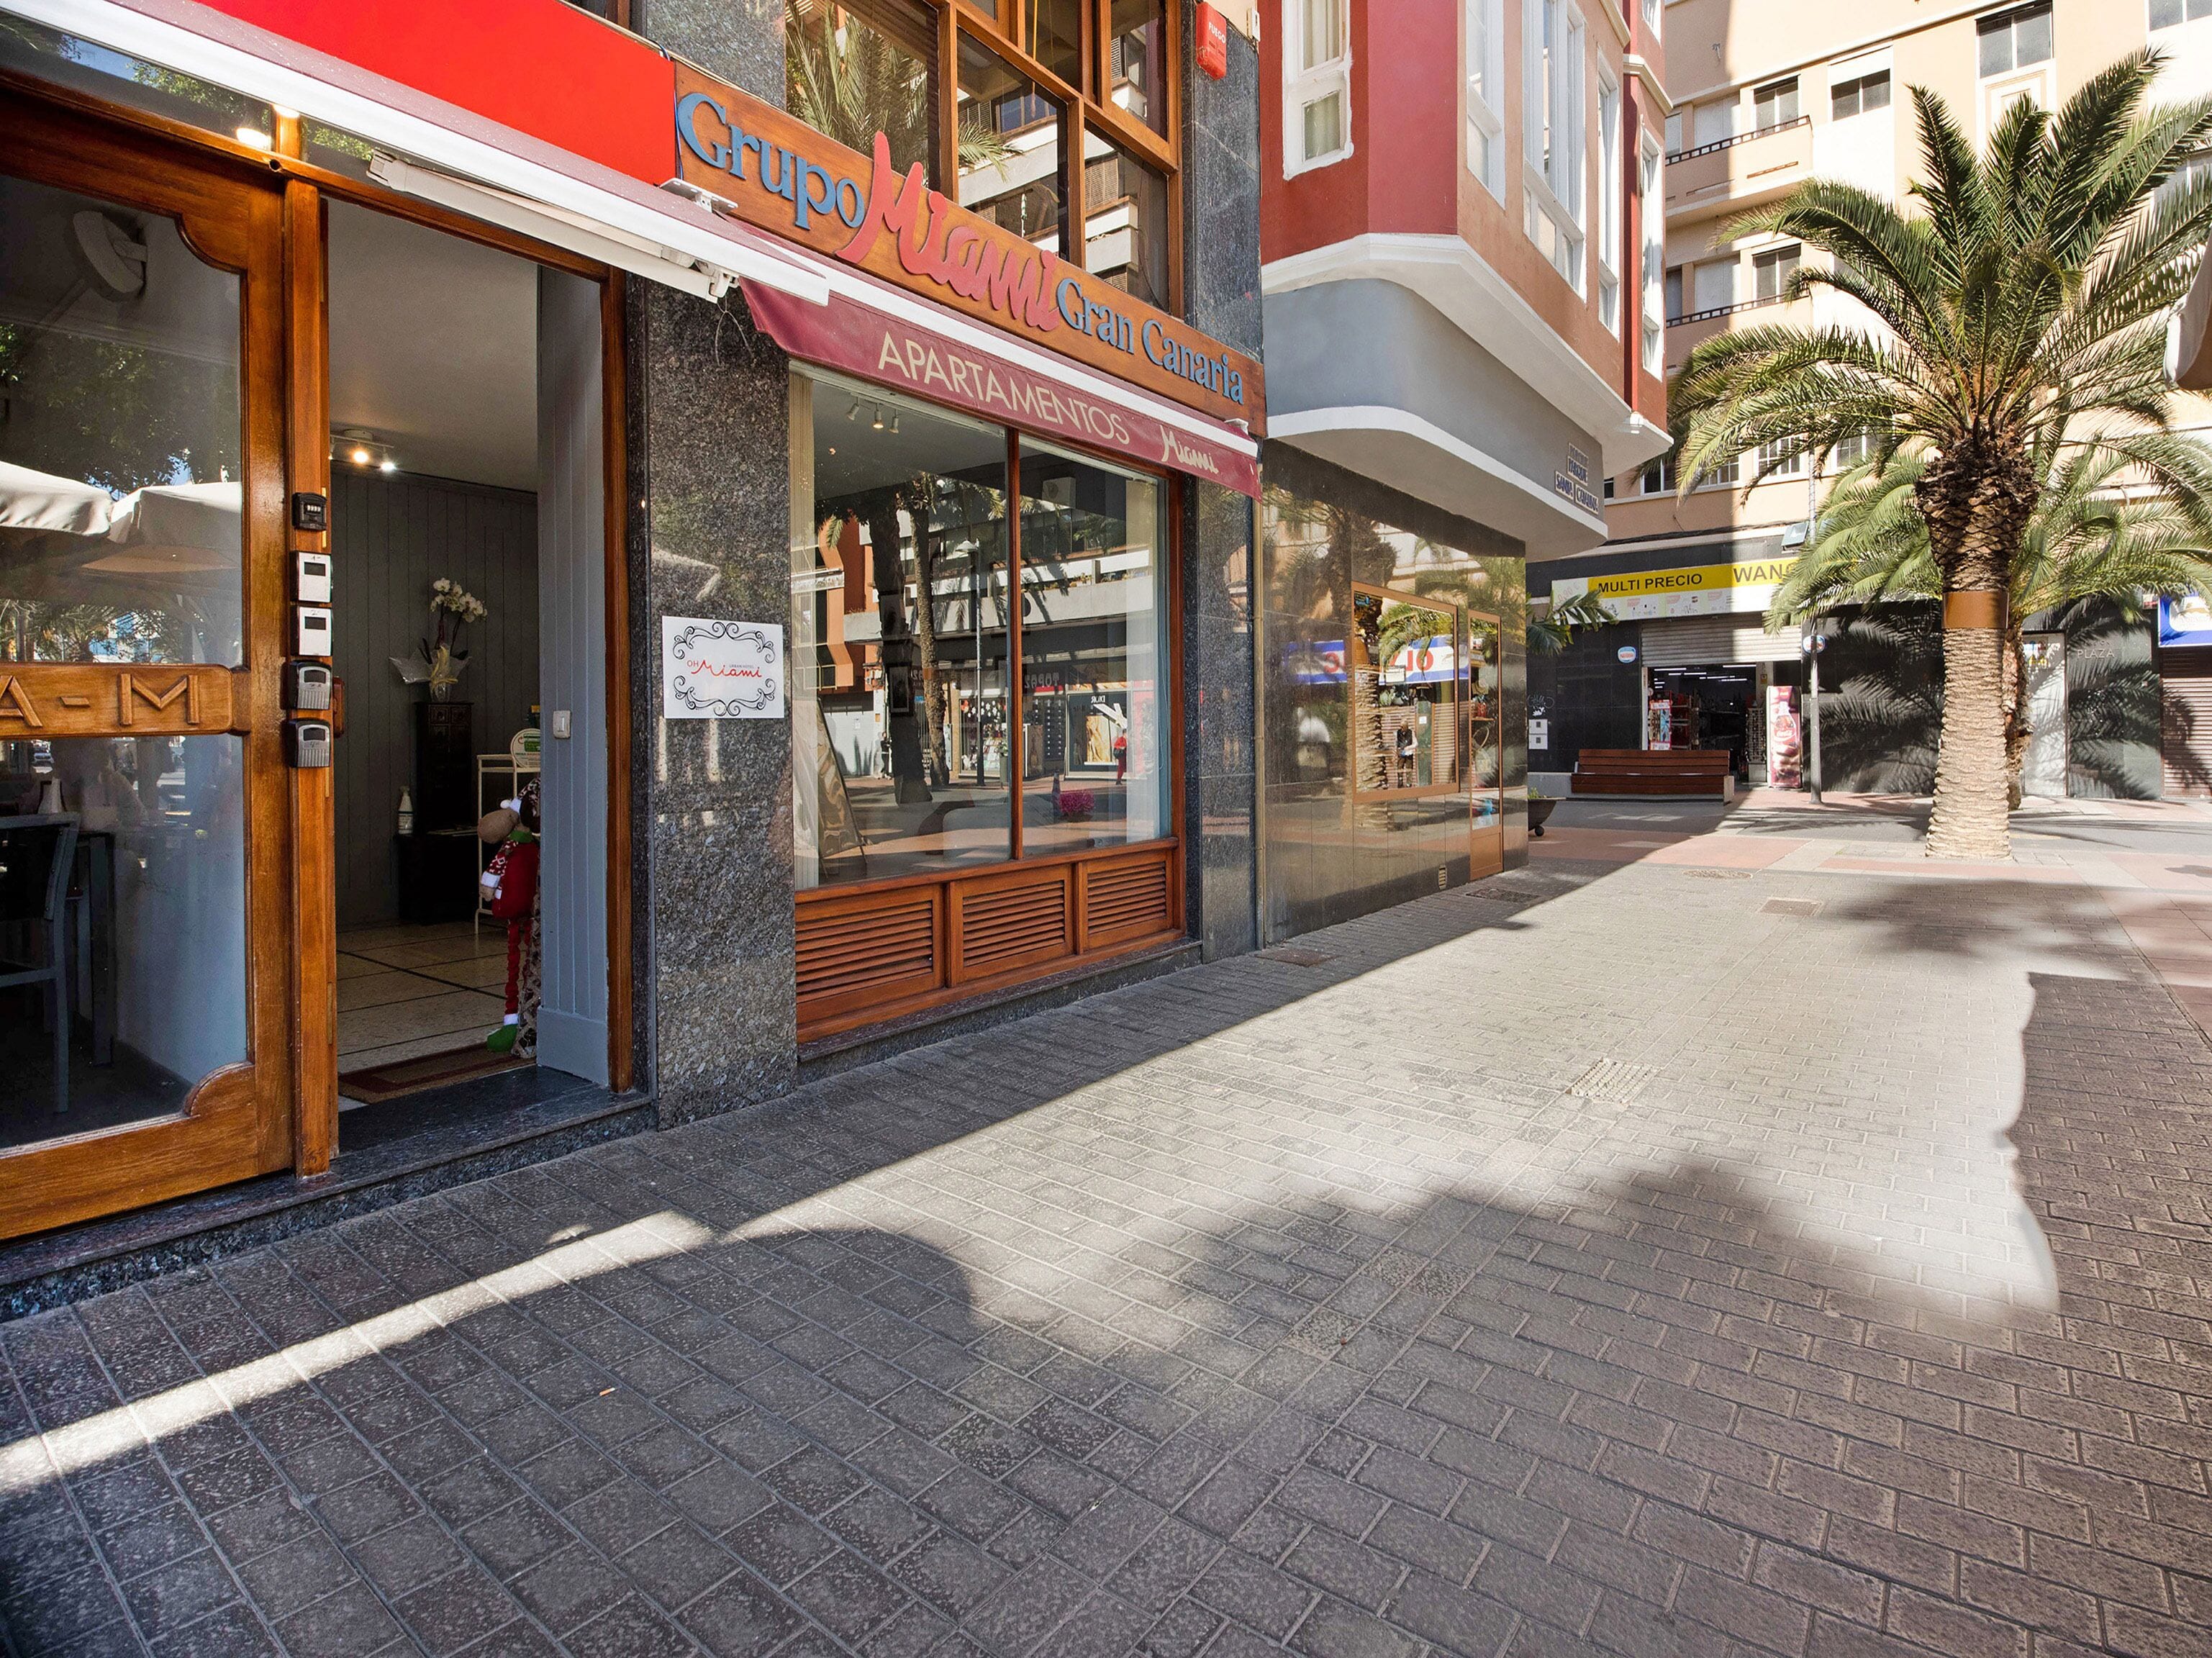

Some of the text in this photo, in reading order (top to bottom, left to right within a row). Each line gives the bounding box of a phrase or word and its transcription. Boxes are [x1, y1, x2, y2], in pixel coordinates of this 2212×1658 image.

[1208, 22, 1226, 43] FUEGO
[677, 93, 1245, 405] Grupo Miami Gran Canaria
[877, 331, 1219, 474] APARTAMENTOS Miami
[1598, 579, 1640, 593] MULTI
[1645, 574, 1703, 589] PRECIO
[2077, 648, 2116, 659] PLAZA
[691, 660, 763, 678] Miami
